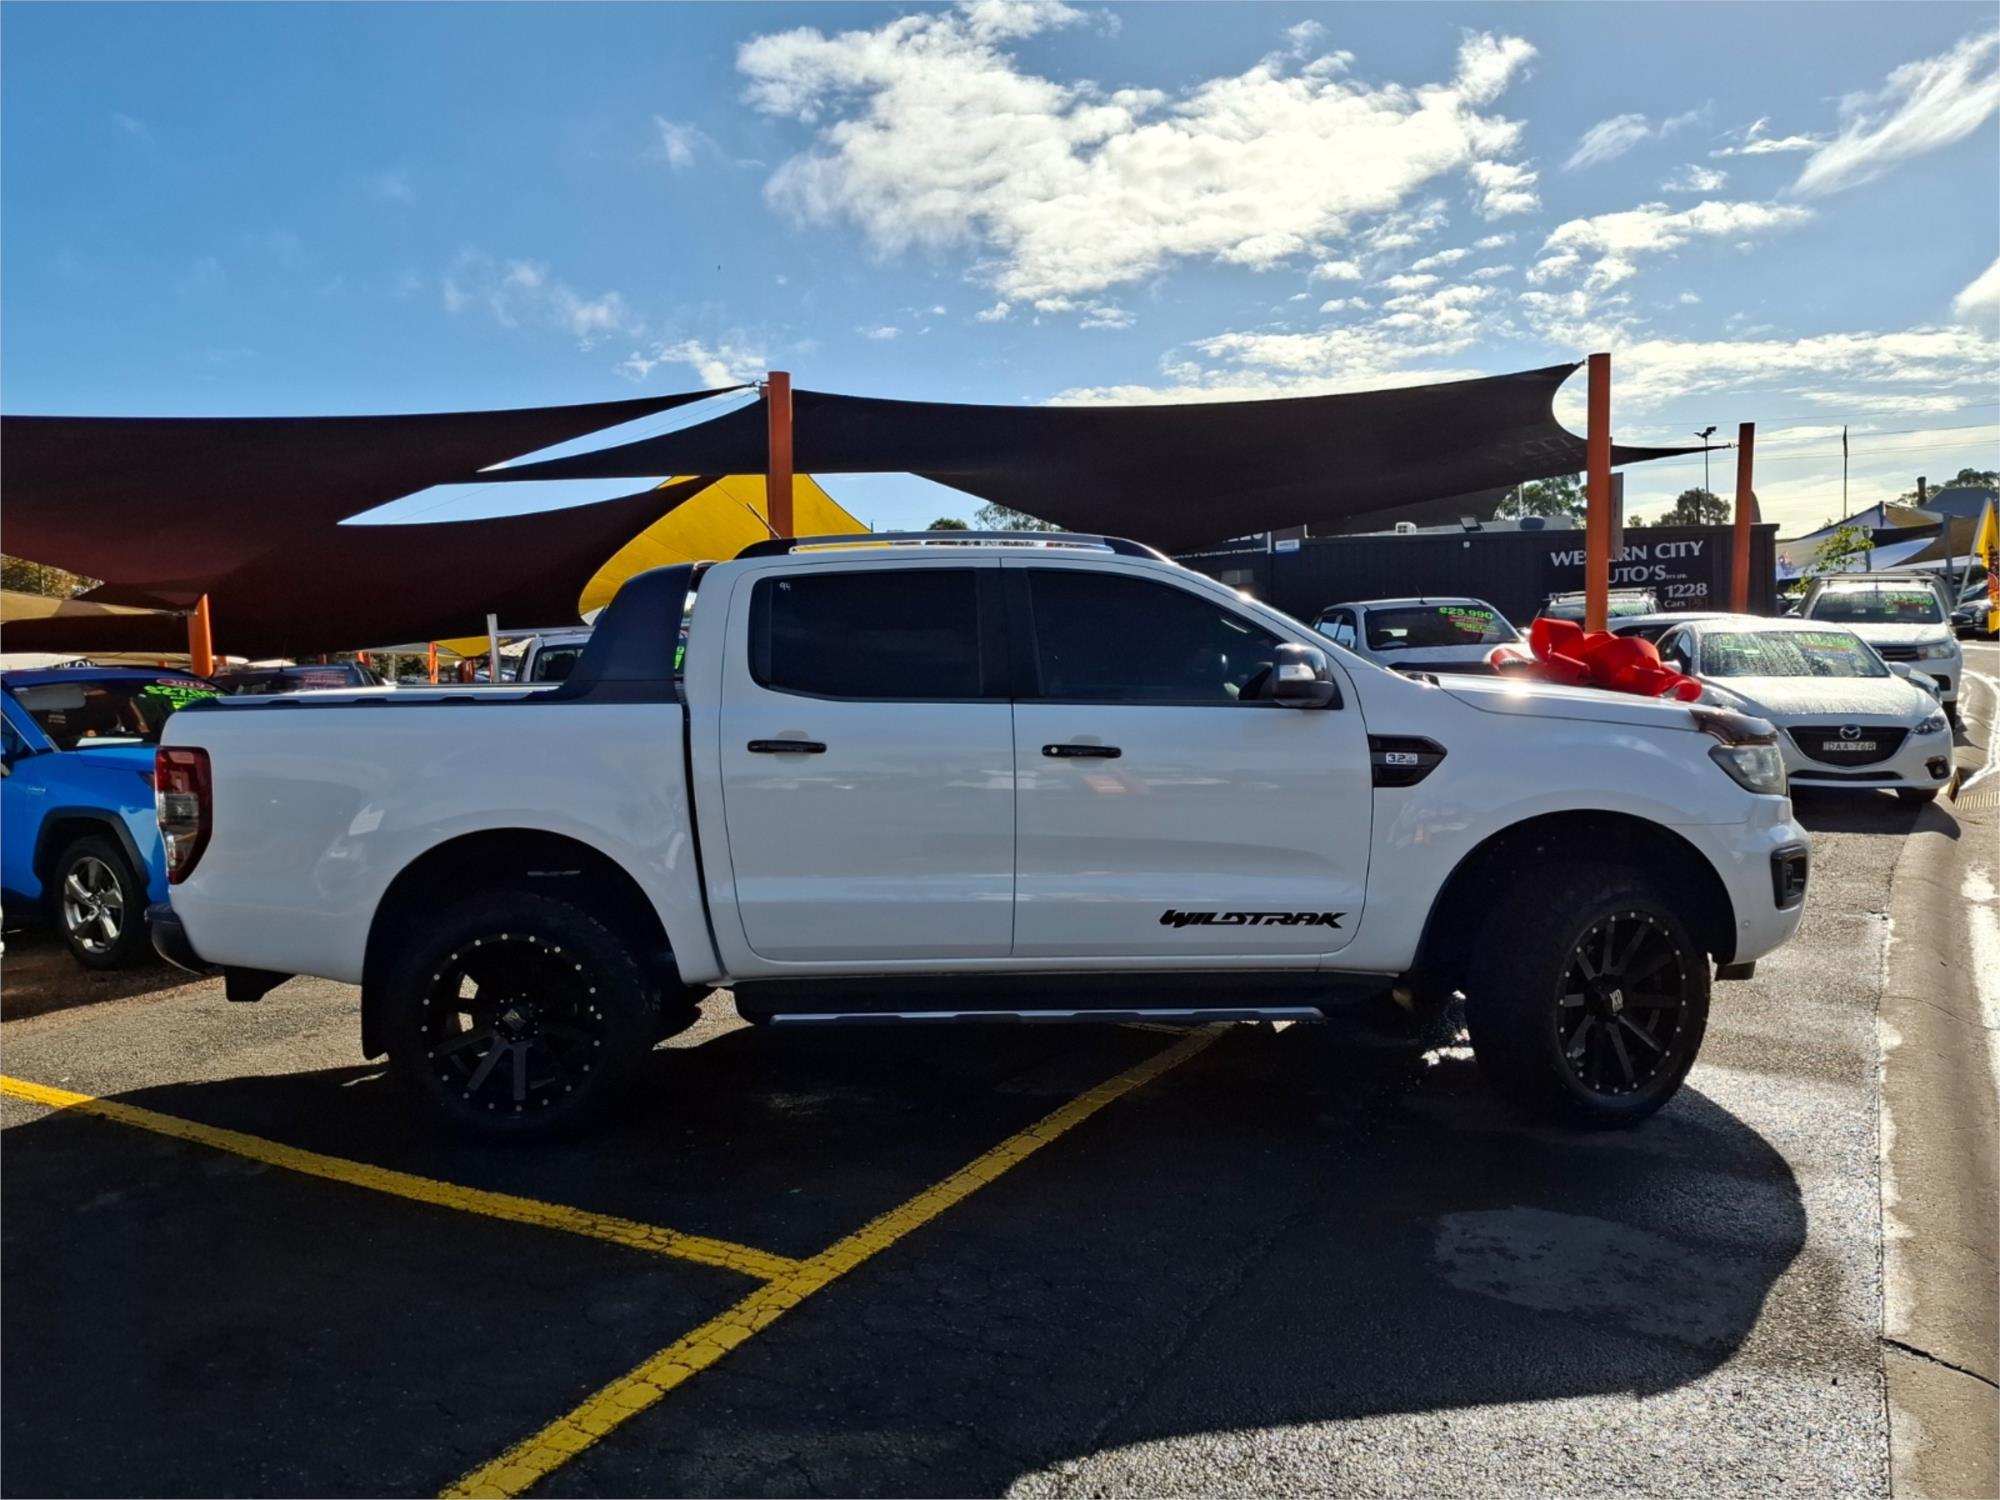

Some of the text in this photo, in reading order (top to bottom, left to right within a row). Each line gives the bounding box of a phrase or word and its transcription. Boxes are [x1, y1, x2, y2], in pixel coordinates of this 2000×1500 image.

[1655, 540, 1704, 559] CITY
[1608, 565, 1666, 584] UTO'S
[1664, 583, 1708, 598] 1228
[1664, 600, 1686, 608] Cars
[1159, 909, 1348, 928] WILDTRAK
